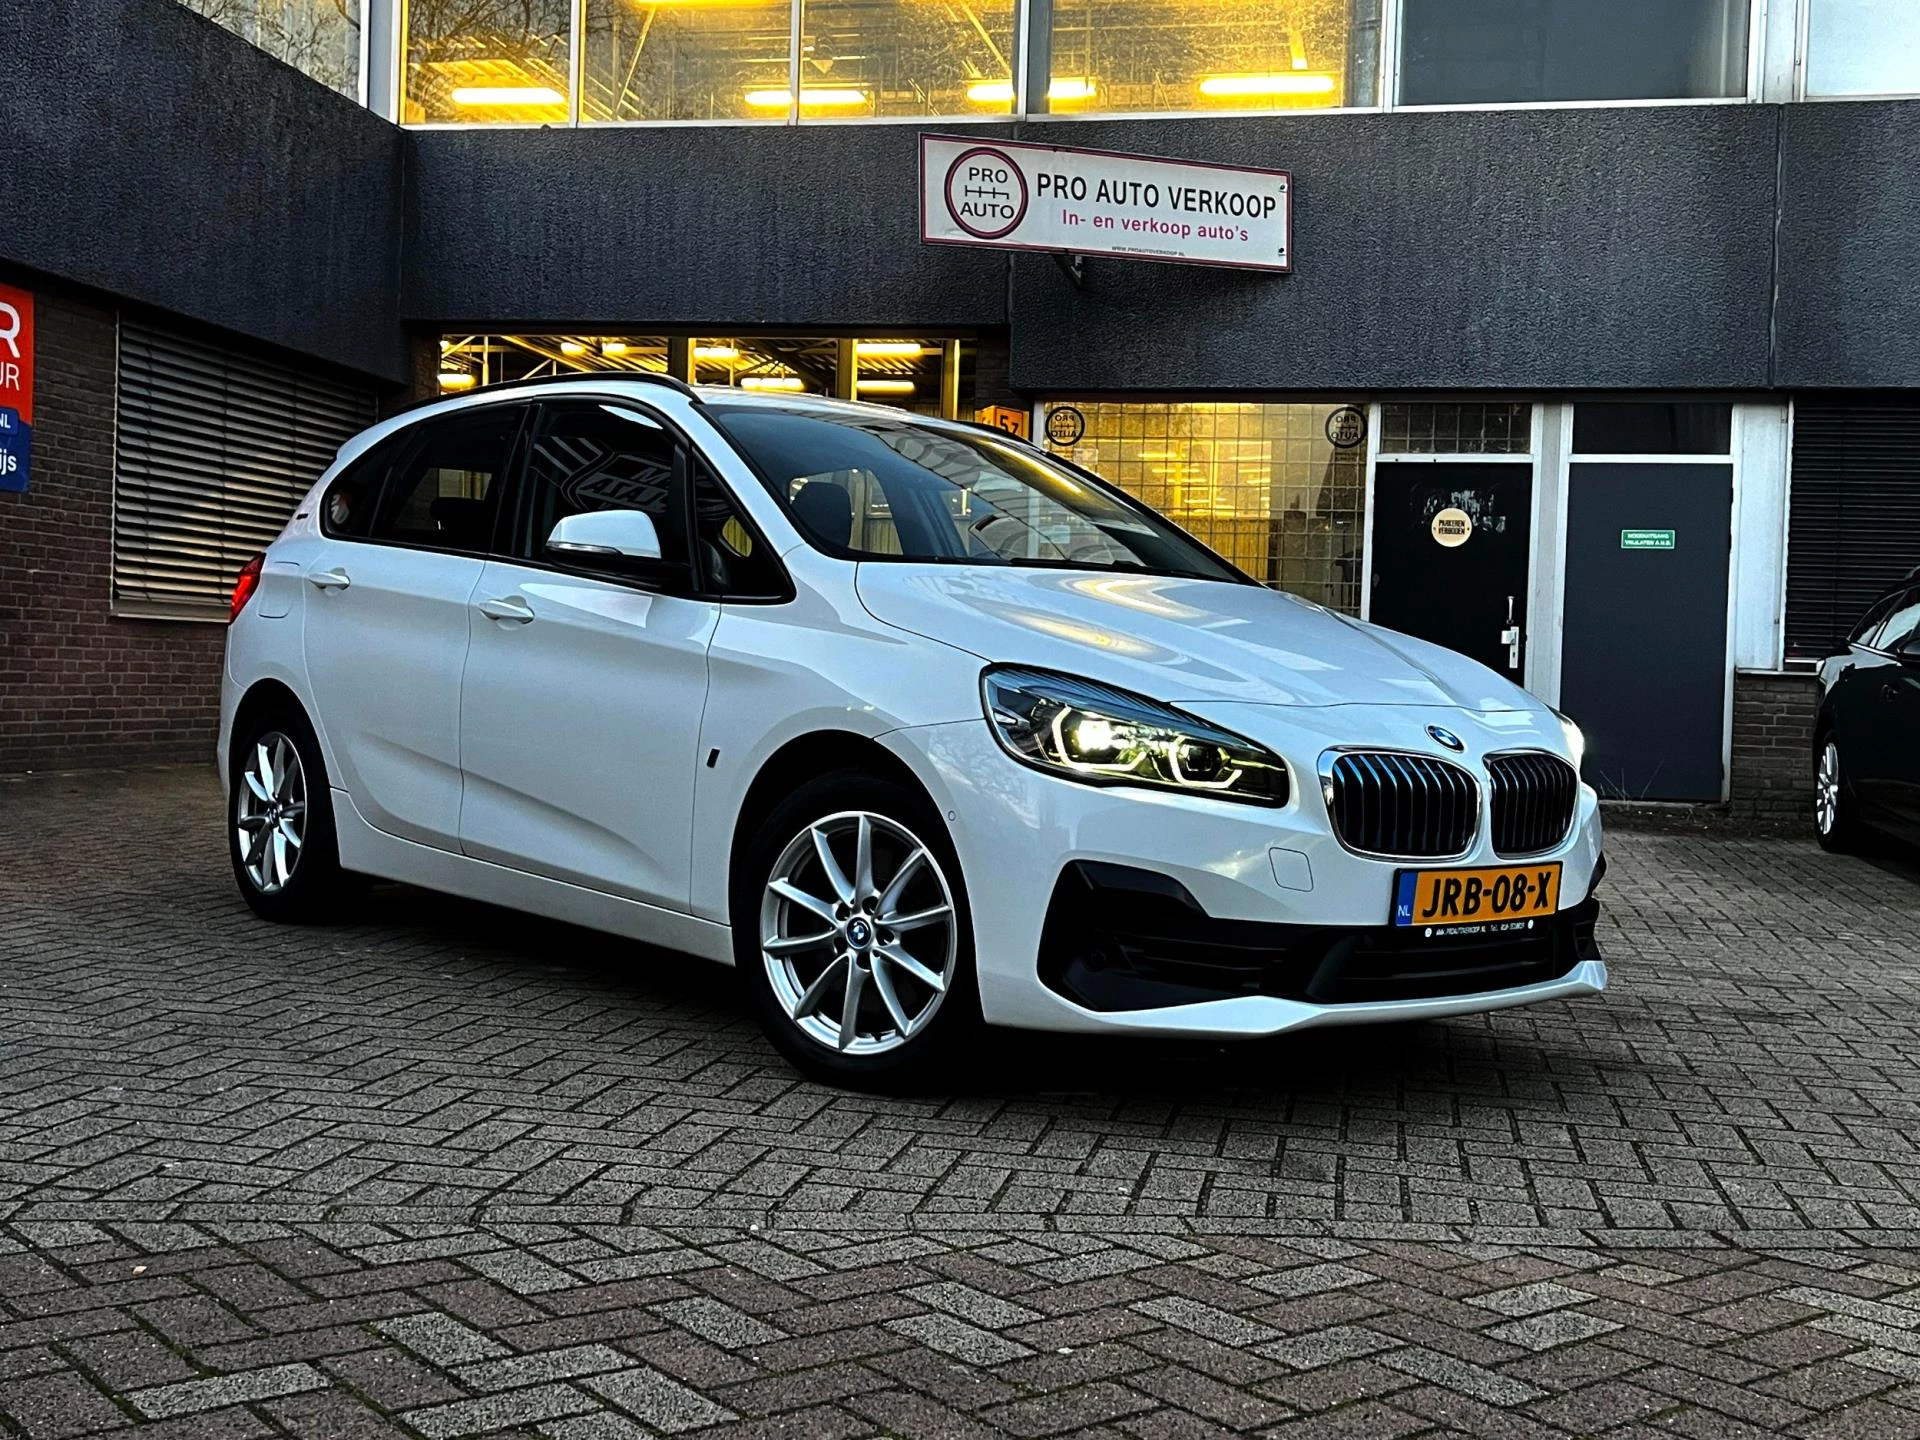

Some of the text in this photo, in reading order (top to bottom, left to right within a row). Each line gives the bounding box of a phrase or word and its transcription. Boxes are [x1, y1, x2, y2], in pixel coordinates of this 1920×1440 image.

[969, 167, 1008, 184] PRO
[1037, 173, 1276, 219] PRO AUTO VERKOOP
[960, 201, 1015, 219] AUTO
[1063, 209, 1249, 241] In- en verkoop auto's
[1422, 872, 1552, 917] JRB-08-X
[1397, 904, 1411, 917] NL
